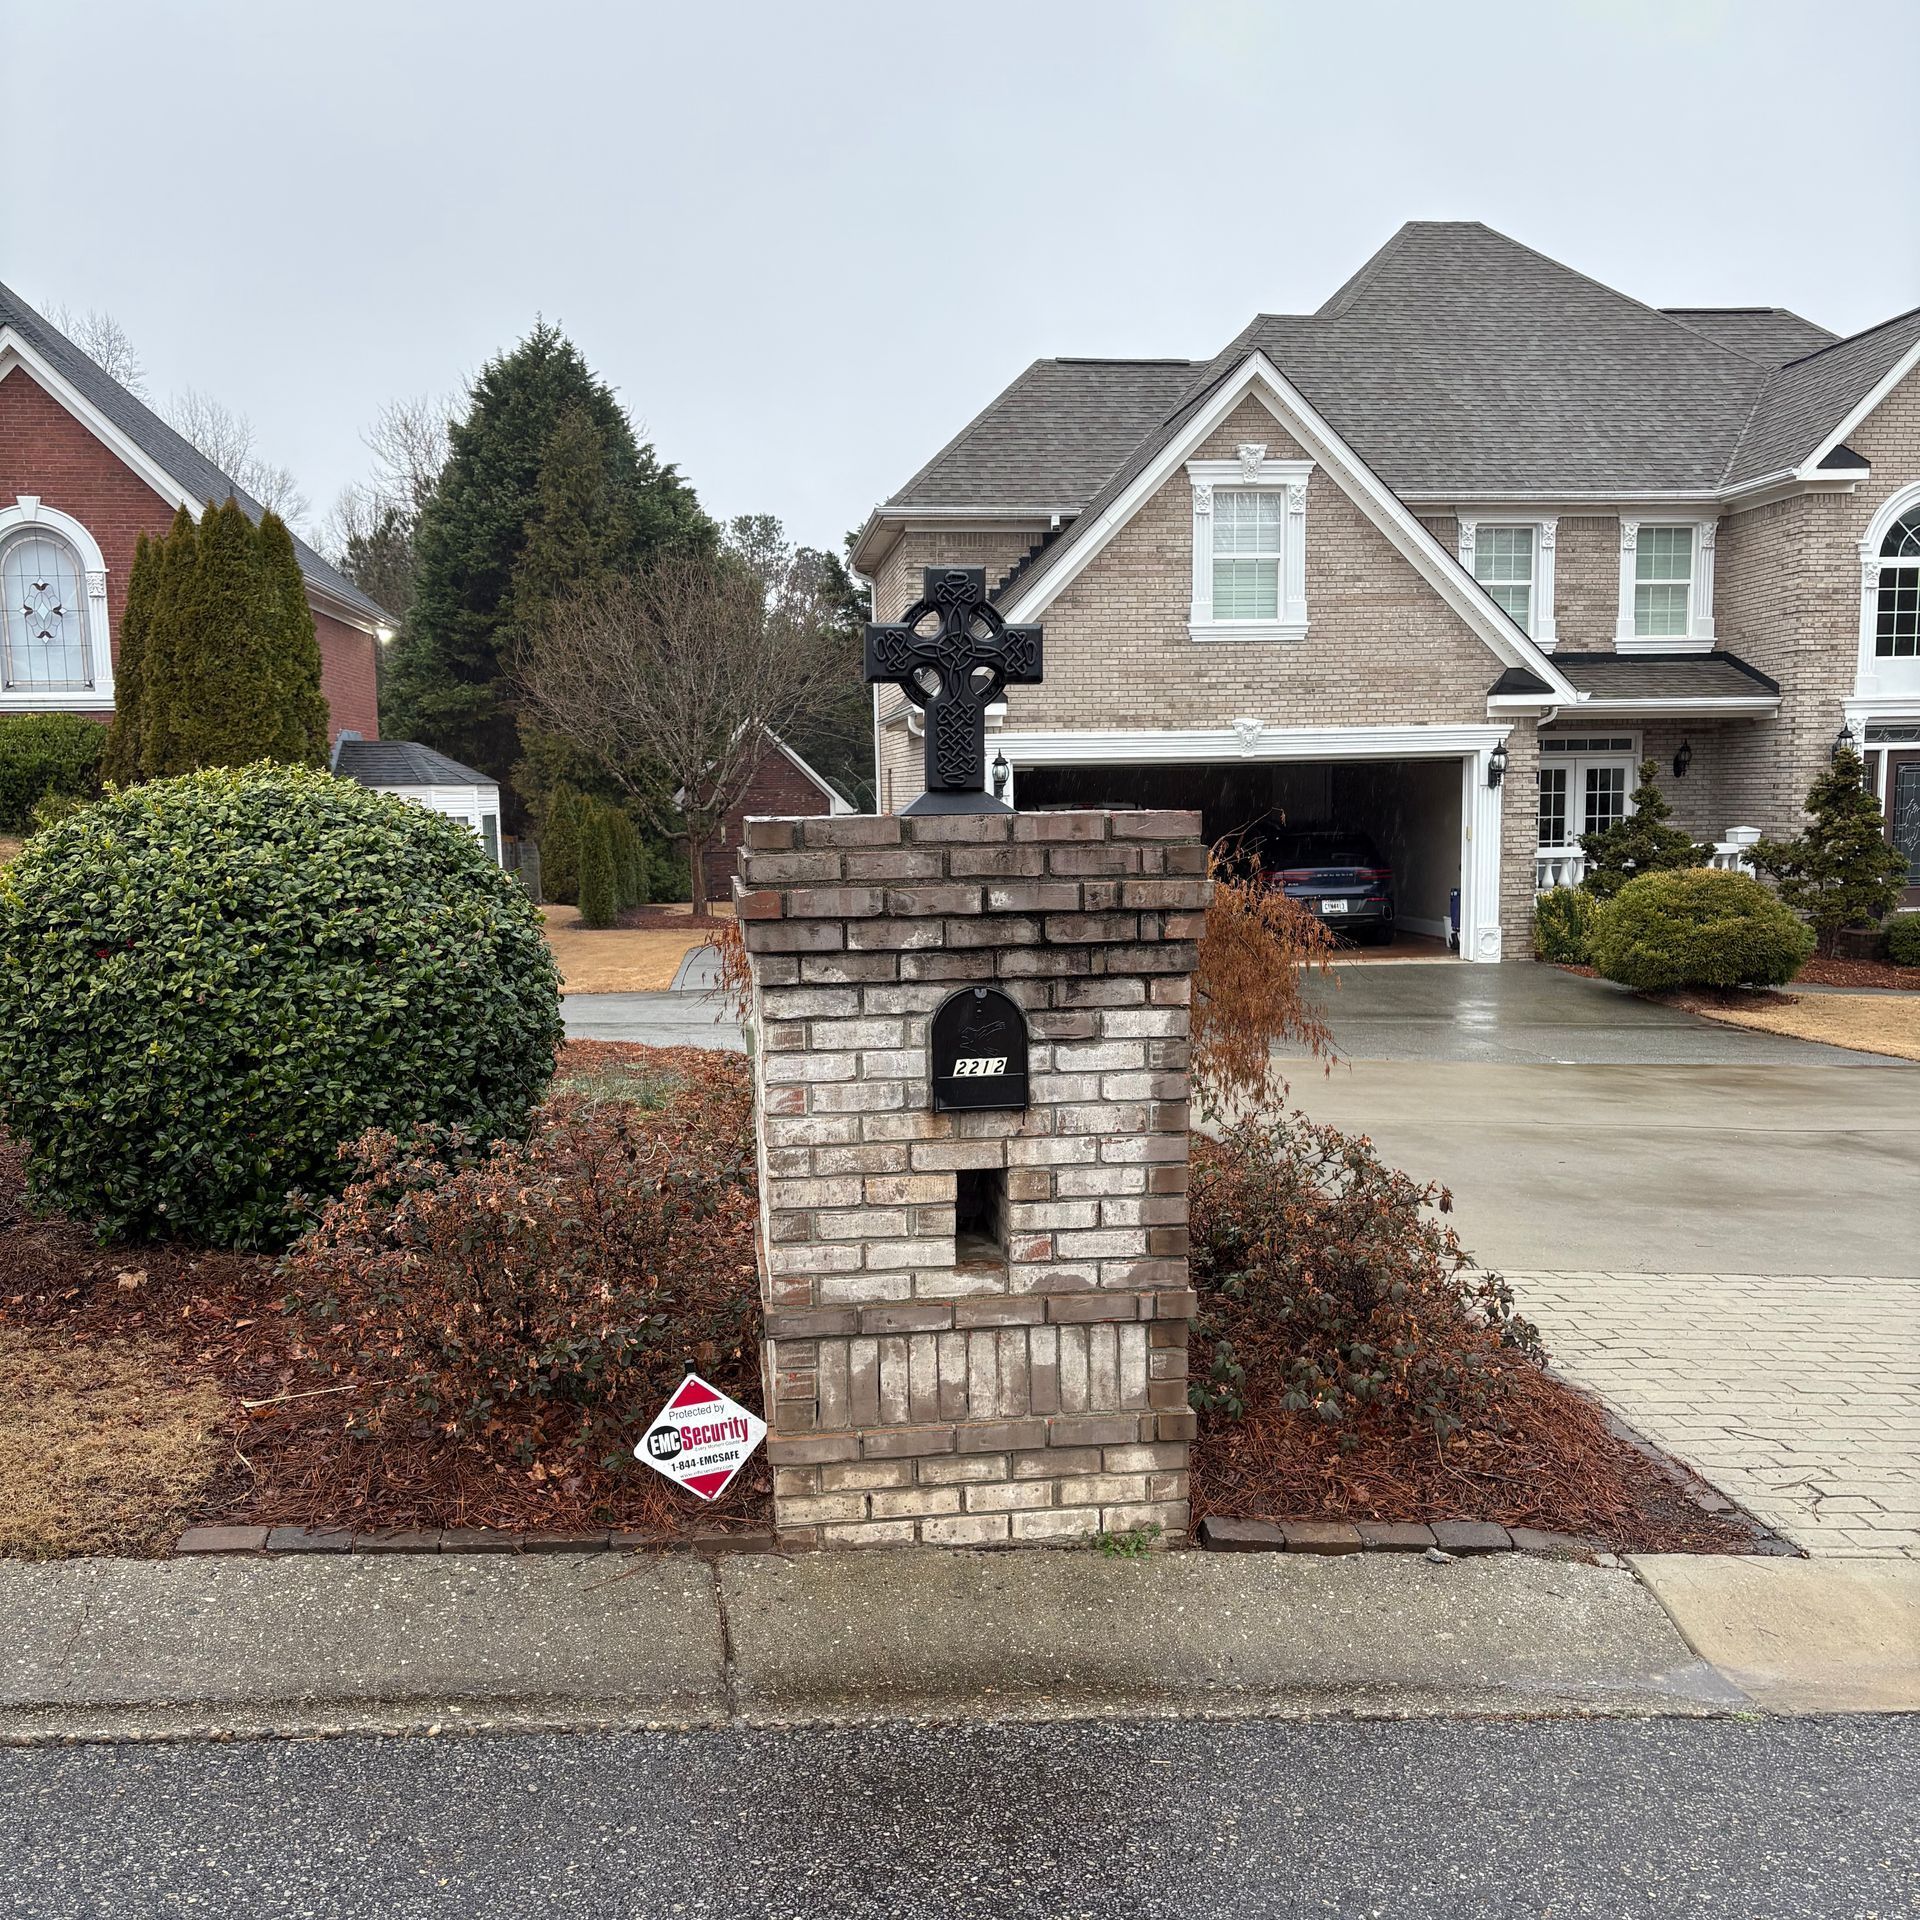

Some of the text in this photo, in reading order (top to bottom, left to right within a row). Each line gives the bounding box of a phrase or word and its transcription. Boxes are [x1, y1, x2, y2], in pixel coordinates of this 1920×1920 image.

[956, 1060, 1005, 1075] 2212
[669, 1403, 725, 1421] Protected by
[650, 1417, 749, 1456] EMC Security
[671, 1450, 740, 1472] 1-844-EMCSAFE
